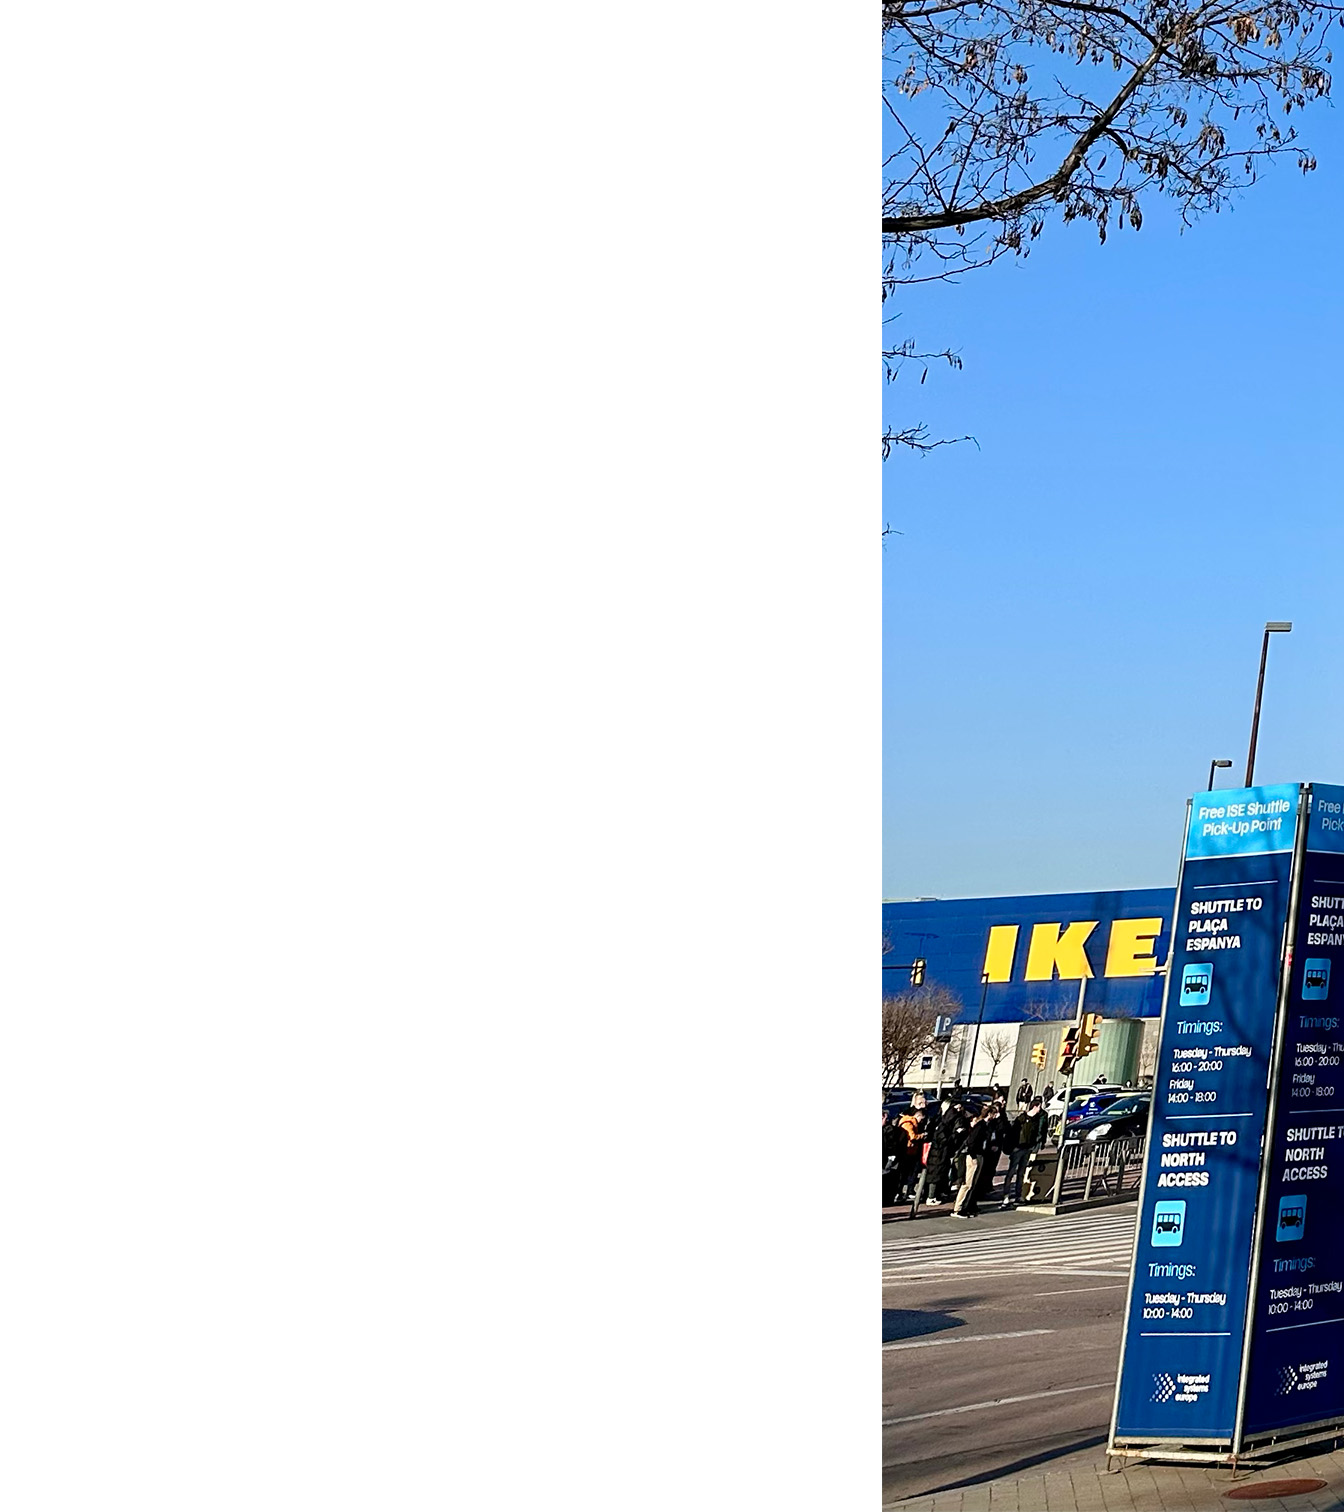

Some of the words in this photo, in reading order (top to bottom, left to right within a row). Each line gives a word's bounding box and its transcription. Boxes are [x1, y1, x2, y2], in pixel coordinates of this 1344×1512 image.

[1200, 805, 1224, 820] Free
[1226, 804, 1245, 817] ISE
[1247, 799, 1290, 816] Shuttle
[1318, 799, 1341, 814] Free
[1203, 821, 1249, 837] Pick-Up
[1250, 817, 1282, 833] Point
[1190, 898, 1244, 915] SHUTTLE
[1245, 898, 1262, 911] TO
[1188, 918, 1228, 935] PLAÇA
[1310, 914, 1344, 931] PLAÇA
[980, 917, 1167, 984] IKE
[1186, 936, 1241, 952] ESPANYA
[942, 1017, 951, 1031] P
[1177, 1020, 1224, 1036] Timings:
[1300, 1015, 1340, 1031] Timings:
[1173, 1047, 1208, 1060] Tuesday
[1214, 1045, 1252, 1058] Thursday
[1296, 1042, 1327, 1054] Tuesday
[1172, 1062, 1193, 1073] 16:00
[1198, 1061, 1223, 1071] 20:00
[1295, 1057, 1313, 1067] 16:00
[1319, 1056, 1340, 1066] 20:00
[1169, 1078, 1194, 1092] Friday
[1292, 1073, 1315, 1085] Friday
[1168, 1092, 1189, 1104] 14:00
[1195, 1091, 1217, 1102] 18:00
[1162, 1133, 1218, 1148] SHUTTLE
[1219, 1131, 1237, 1145] TO
[1287, 1126, 1335, 1142] SHUTTLE
[1160, 1152, 1206, 1168] NORTH
[1285, 1147, 1324, 1162] NORTH
[1157, 1171, 1210, 1188] ACCESS
[1282, 1165, 1328, 1182] ACCESS
[1148, 1262, 1197, 1280] Timings:
[1273, 1256, 1316, 1274] Timings:
[1270, 1286, 1303, 1300] Tuesday
[1308, 1280, 1343, 1294] Thursday
[1145, 1292, 1181, 1306] Tuesday
[1187, 1292, 1226, 1306] Thursday
[1268, 1302, 1289, 1315] 10:00
[1294, 1298, 1314, 1311] 14:00
[1143, 1308, 1165, 1320] 10:00
[1171, 1308, 1193, 1319] 14:00
[1299, 1360, 1328, 1373] integrated
[1176, 1373, 1210, 1385] integrated
[1305, 1370, 1327, 1382] systems
[1183, 1384, 1209, 1394] systems
[1297, 1380, 1317, 1391] europe
[1175, 1393, 1198, 1403] europe
